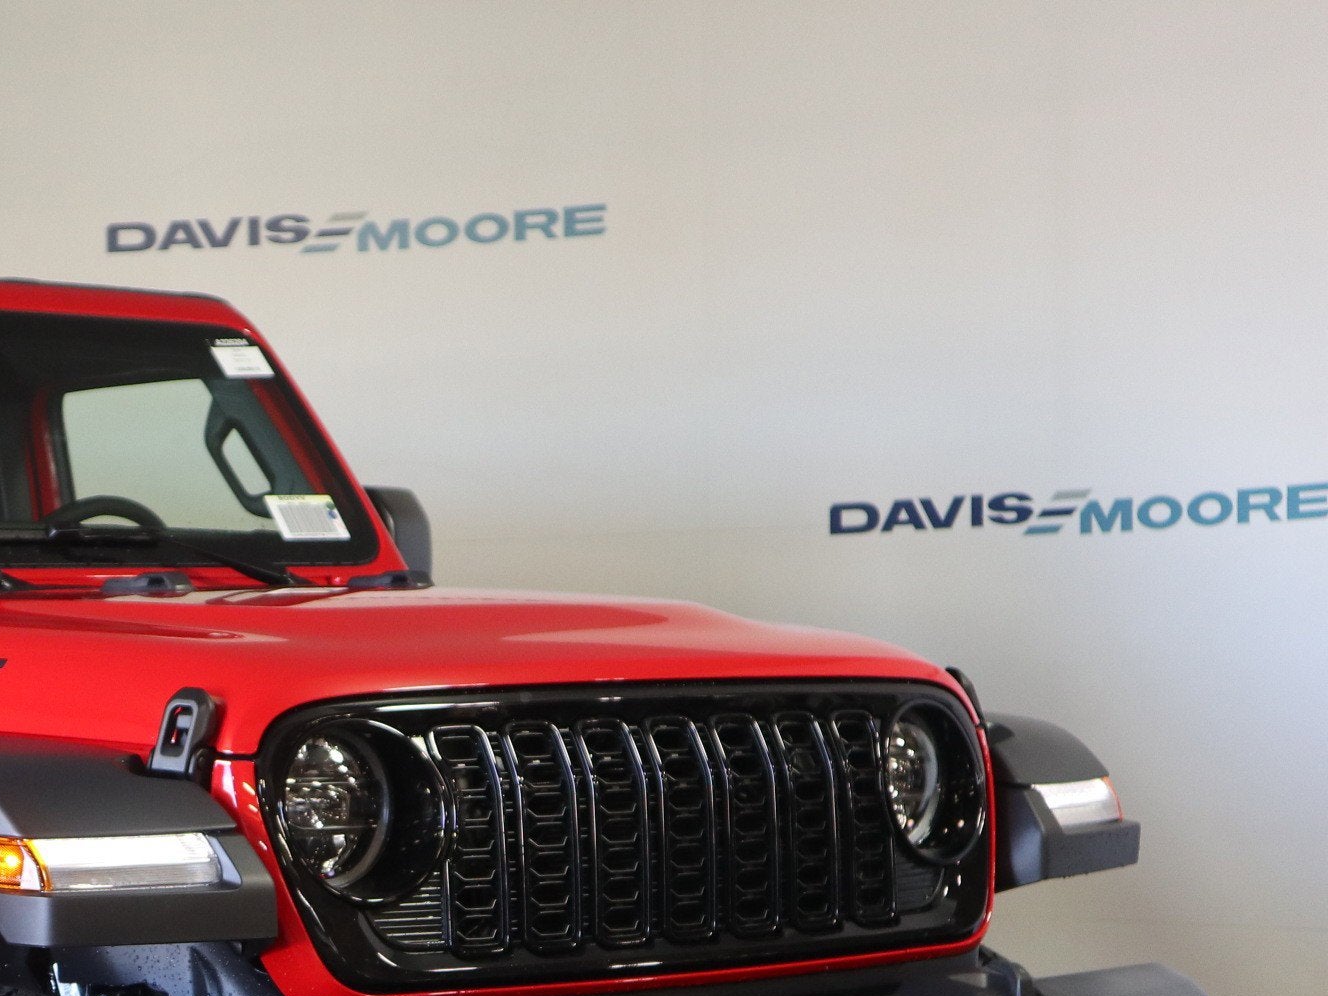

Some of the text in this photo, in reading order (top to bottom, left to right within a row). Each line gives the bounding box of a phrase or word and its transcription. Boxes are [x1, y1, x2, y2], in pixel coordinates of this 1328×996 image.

[107, 203, 607, 252] DAVIS MOORE
[829, 482, 1328, 534] DAVIS MOORE
